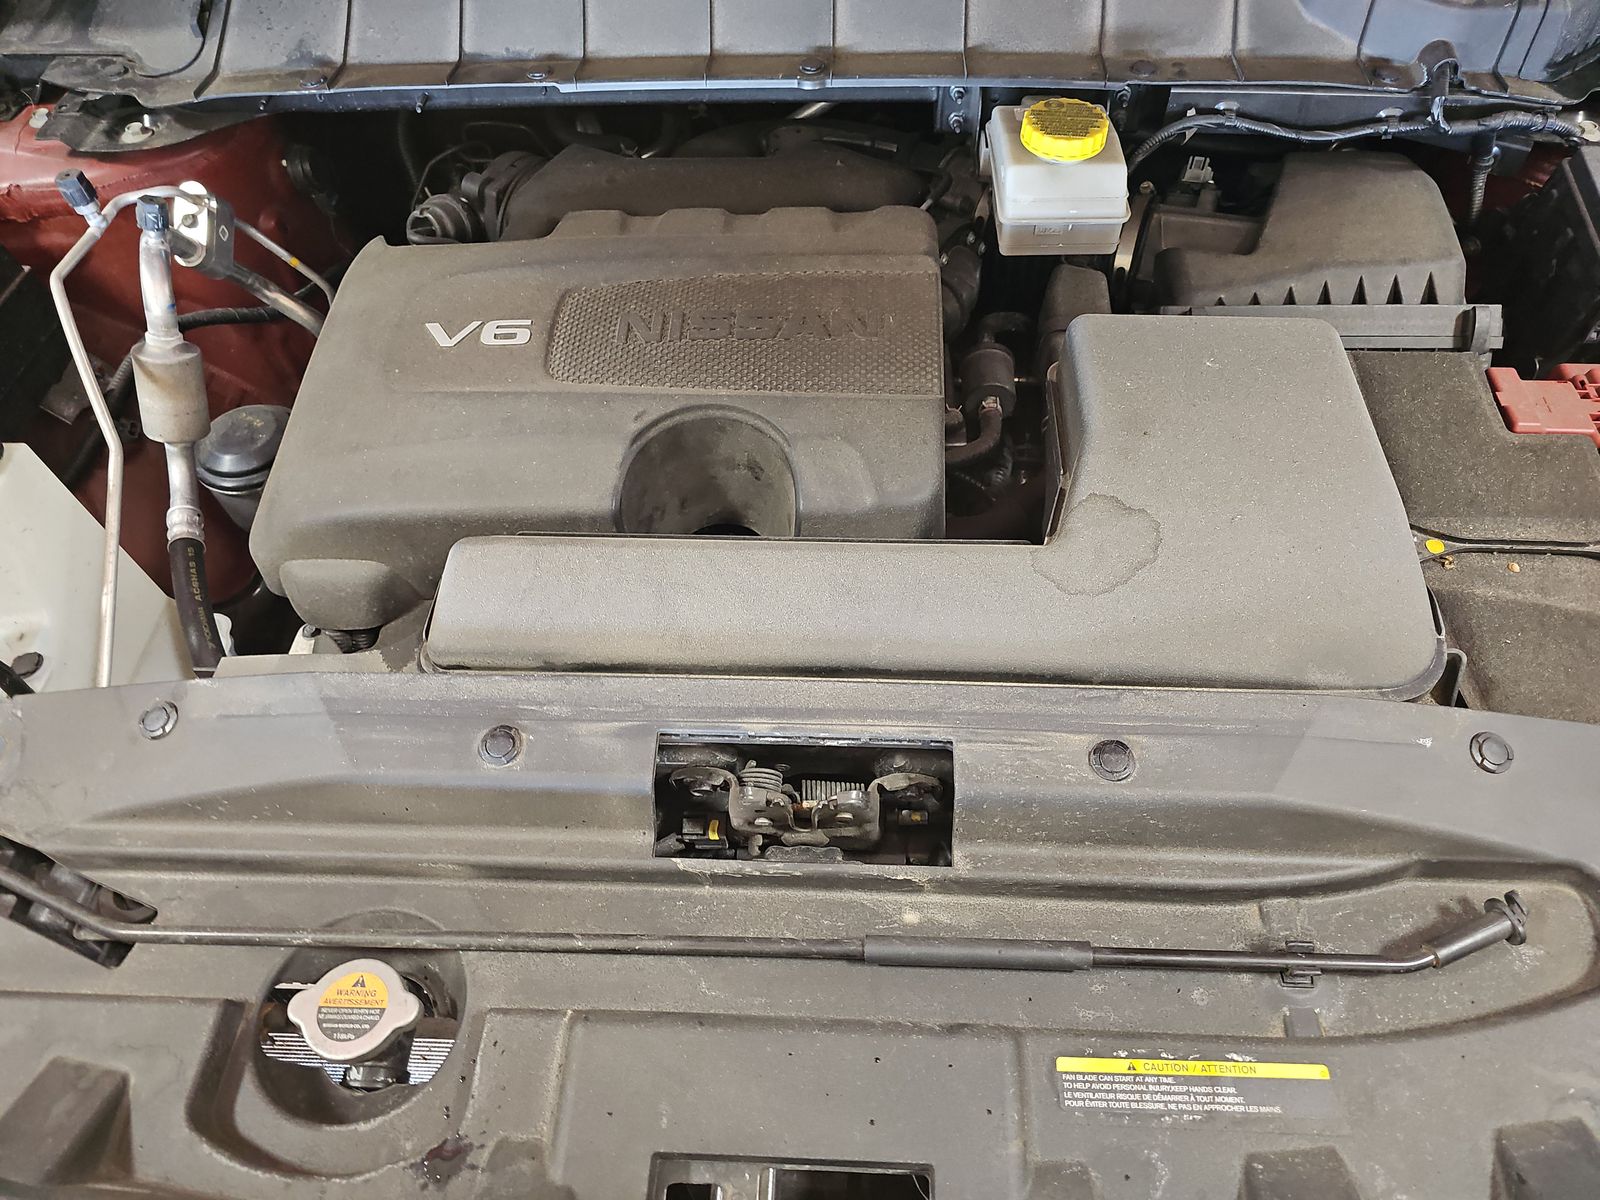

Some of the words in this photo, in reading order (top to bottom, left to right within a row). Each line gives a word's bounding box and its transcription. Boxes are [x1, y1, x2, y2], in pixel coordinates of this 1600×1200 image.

[425, 320, 533, 346] V6
[615, 307, 890, 344] NISSAN
[336, 988, 377, 998] WARNING
[323, 998, 385, 1006] AVERTISSEMENT
[1143, 1062, 1189, 1072] CAUTION
[1200, 1064, 1257, 1074] ATTENTION
[1073, 1092, 1115, 1100] VENTILATEUR
[1152, 1093, 1189, 1101] DÉMARRER
[1190, 1093, 1197, 1102] À
[1085, 1099, 1108, 1108] ÉVITER
[1108, 1101, 1130, 1109] TOUTE
